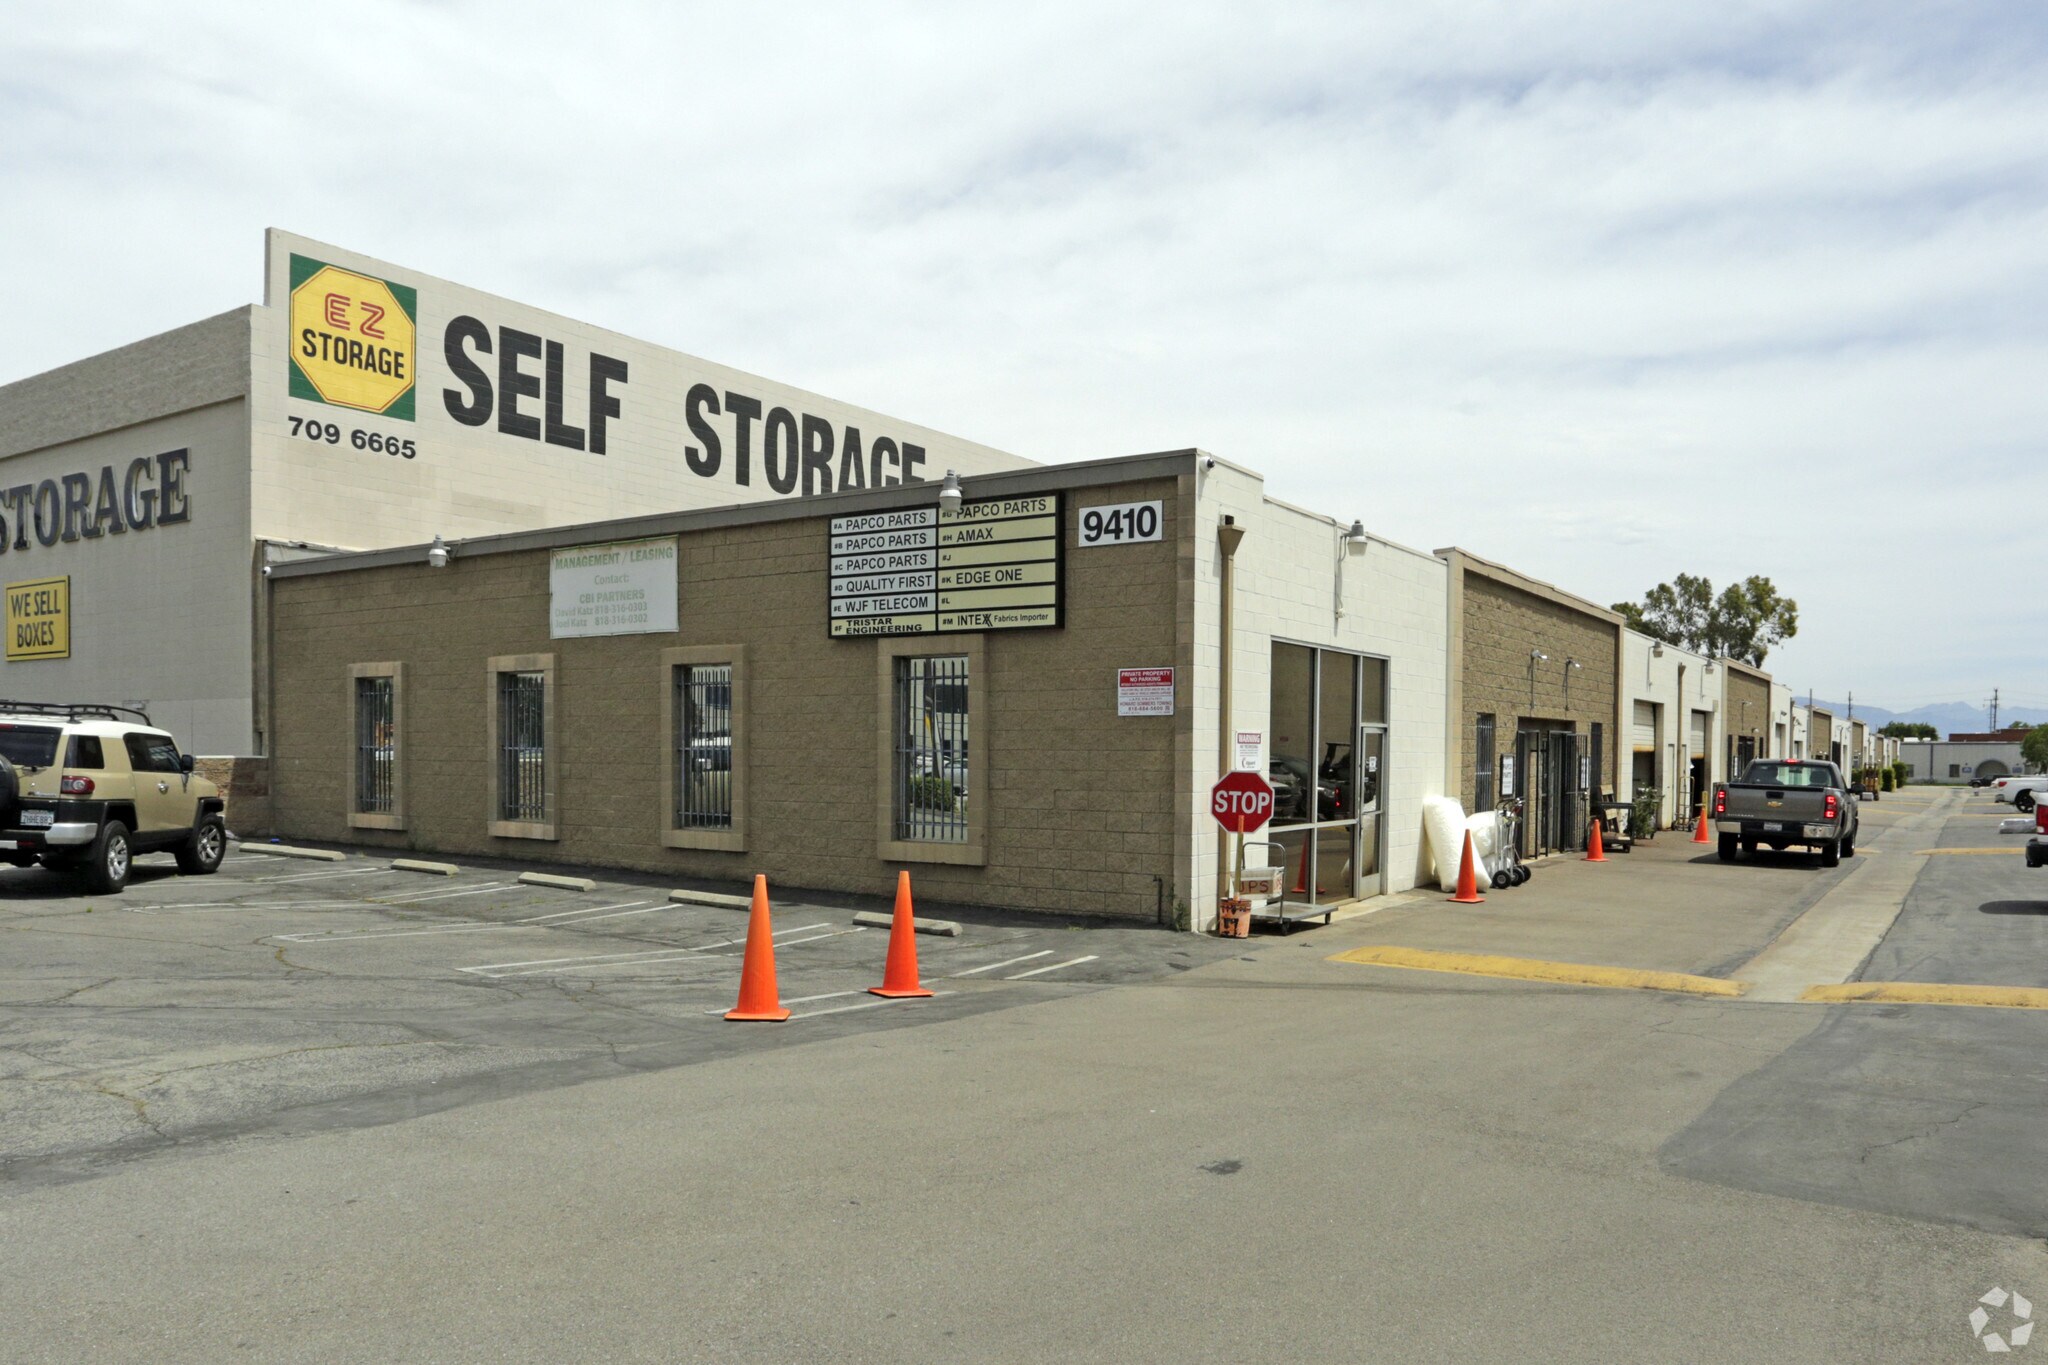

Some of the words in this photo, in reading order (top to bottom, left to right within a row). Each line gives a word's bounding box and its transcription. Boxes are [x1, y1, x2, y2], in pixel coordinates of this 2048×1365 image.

[325, 293, 385, 340] EZ
[302, 328, 405, 380] STORAGE
[442, 315, 628, 455] SELF
[288, 415, 341, 445] 709
[351, 429, 416, 460] 6665
[957, 503, 1000, 519] PAPCO
[1003, 499, 1047, 514] PARTS
[846, 516, 885, 531] PAPCO
[888, 512, 927, 527] PARTS
[1083, 505, 1157, 542] 9410
[846, 536, 885, 550] PAPCO
[888, 532, 927, 547] PARTS
[956, 527, 994, 542] AMAX
[555, 552, 621, 569] MANAGEMENT
[630, 547, 674, 562] LEASING
[846, 557, 886, 571] PAPCO
[889, 553, 928, 568] PARTS
[846, 577, 896, 592] QUALITY
[898, 575, 933, 588] FIRST
[956, 570, 991, 584] EDGE
[994, 569, 1023, 581] ONE
[10, 592, 31, 618] WE
[34, 589, 62, 616] SELL
[579, 593, 595, 604] CBI
[596, 589, 645, 603] PARTNERS
[845, 600, 869, 612] WJF
[871, 596, 928, 611] TELECOM
[846, 617, 893, 627] TRISTAR
[994, 614, 1018, 623] Fabrics
[1020, 613, 1049, 622] Importer
[17, 620, 55, 649] BOXES
[846, 624, 923, 635] ENGINEERING
[1214, 790, 1271, 814] STOP
